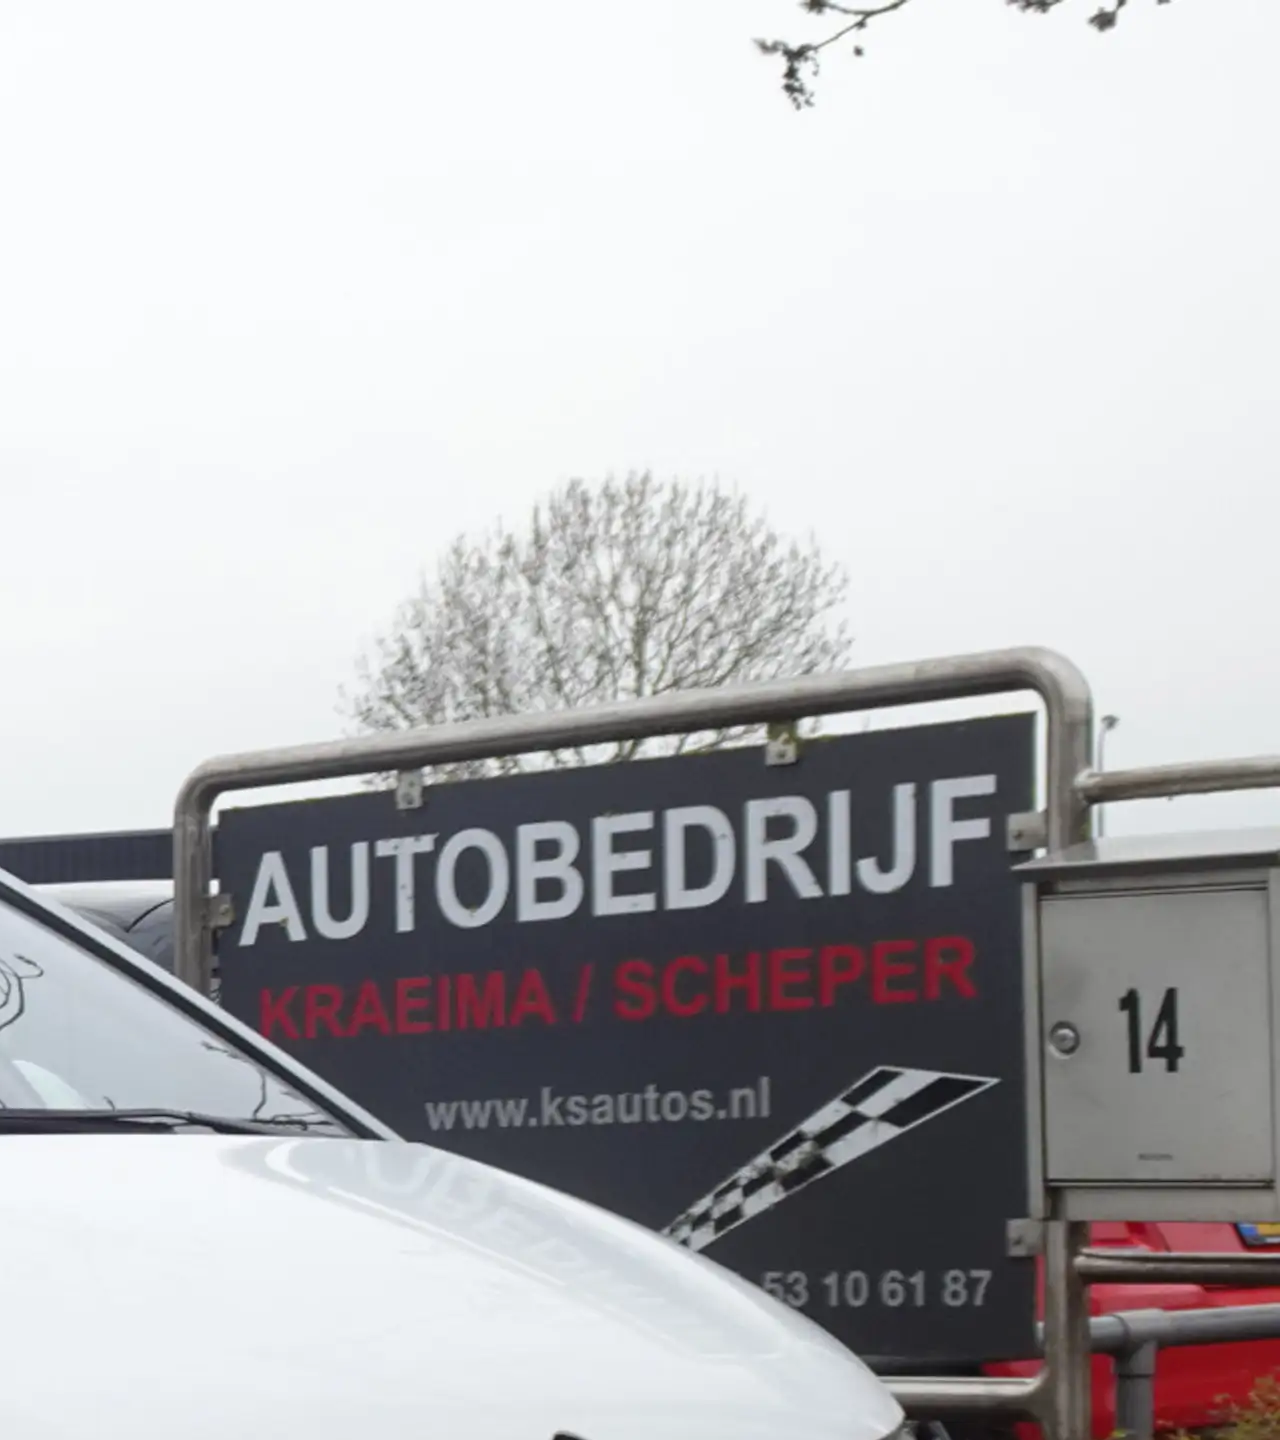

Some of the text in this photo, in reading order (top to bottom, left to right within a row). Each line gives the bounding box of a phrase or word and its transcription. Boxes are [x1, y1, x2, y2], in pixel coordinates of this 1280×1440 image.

[239, 774, 998, 947] AUTOBEDRIJF
[258, 935, 978, 1040] KRAEIMA / SCHEPER
[1117, 986, 1186, 1074] 14
[425, 1076, 772, 1132] www.ksautos.nl
[763, 1268, 992, 1307] 53 10 61 87
